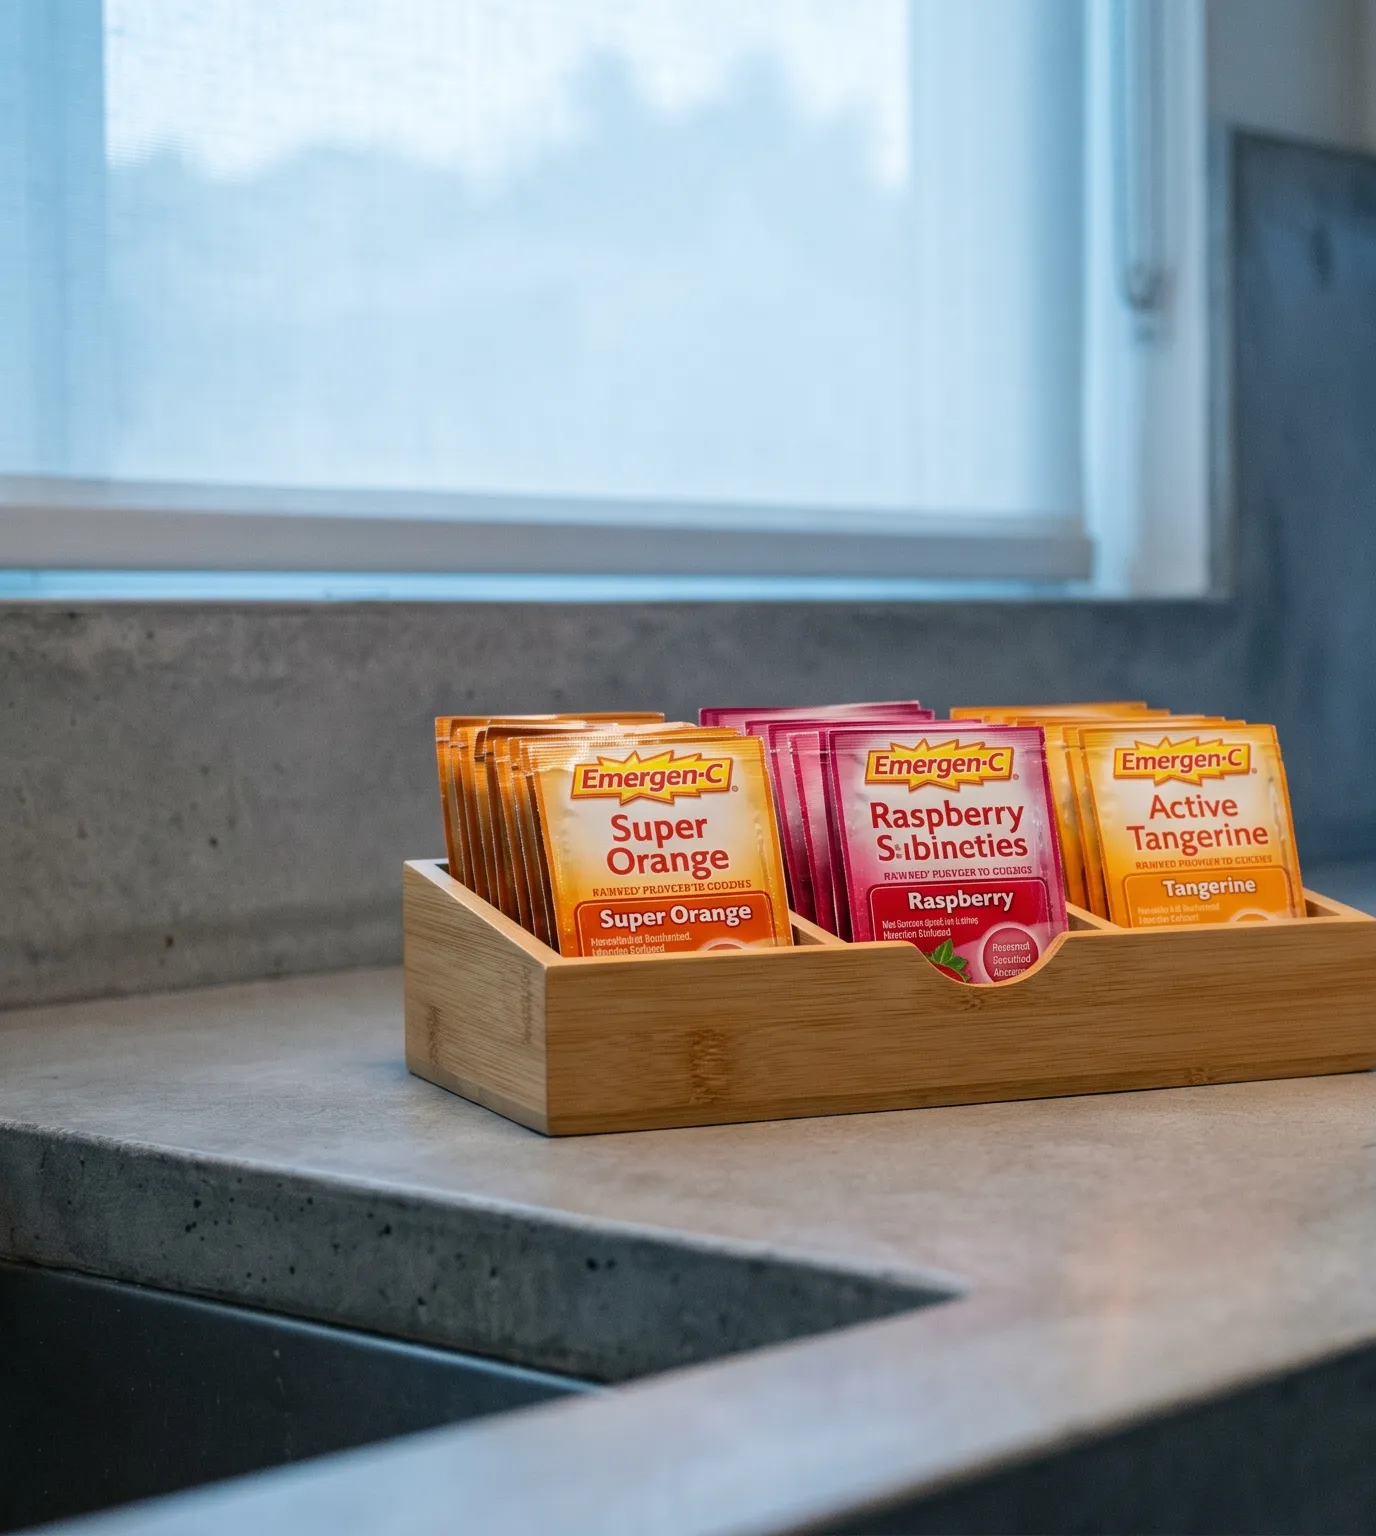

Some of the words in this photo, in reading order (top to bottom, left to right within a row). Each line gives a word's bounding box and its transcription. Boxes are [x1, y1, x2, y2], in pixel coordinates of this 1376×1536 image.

[874, 752, 1005, 778] Emergen-C
[1122, 749, 1242, 774] Emergen-C
[581, 762, 724, 793] Emergen-C
[870, 800, 1024, 834] Raspberry
[1149, 794, 1238, 820] Active
[610, 814, 708, 849] Super
[1126, 823, 1269, 857] Tangerine
[606, 846, 729, 880] Orange
[908, 890, 1014, 914] Raspberry
[1162, 876, 1257, 901] Tangerine
[600, 908, 666, 933] Super
[670, 904, 752, 927] Orange
